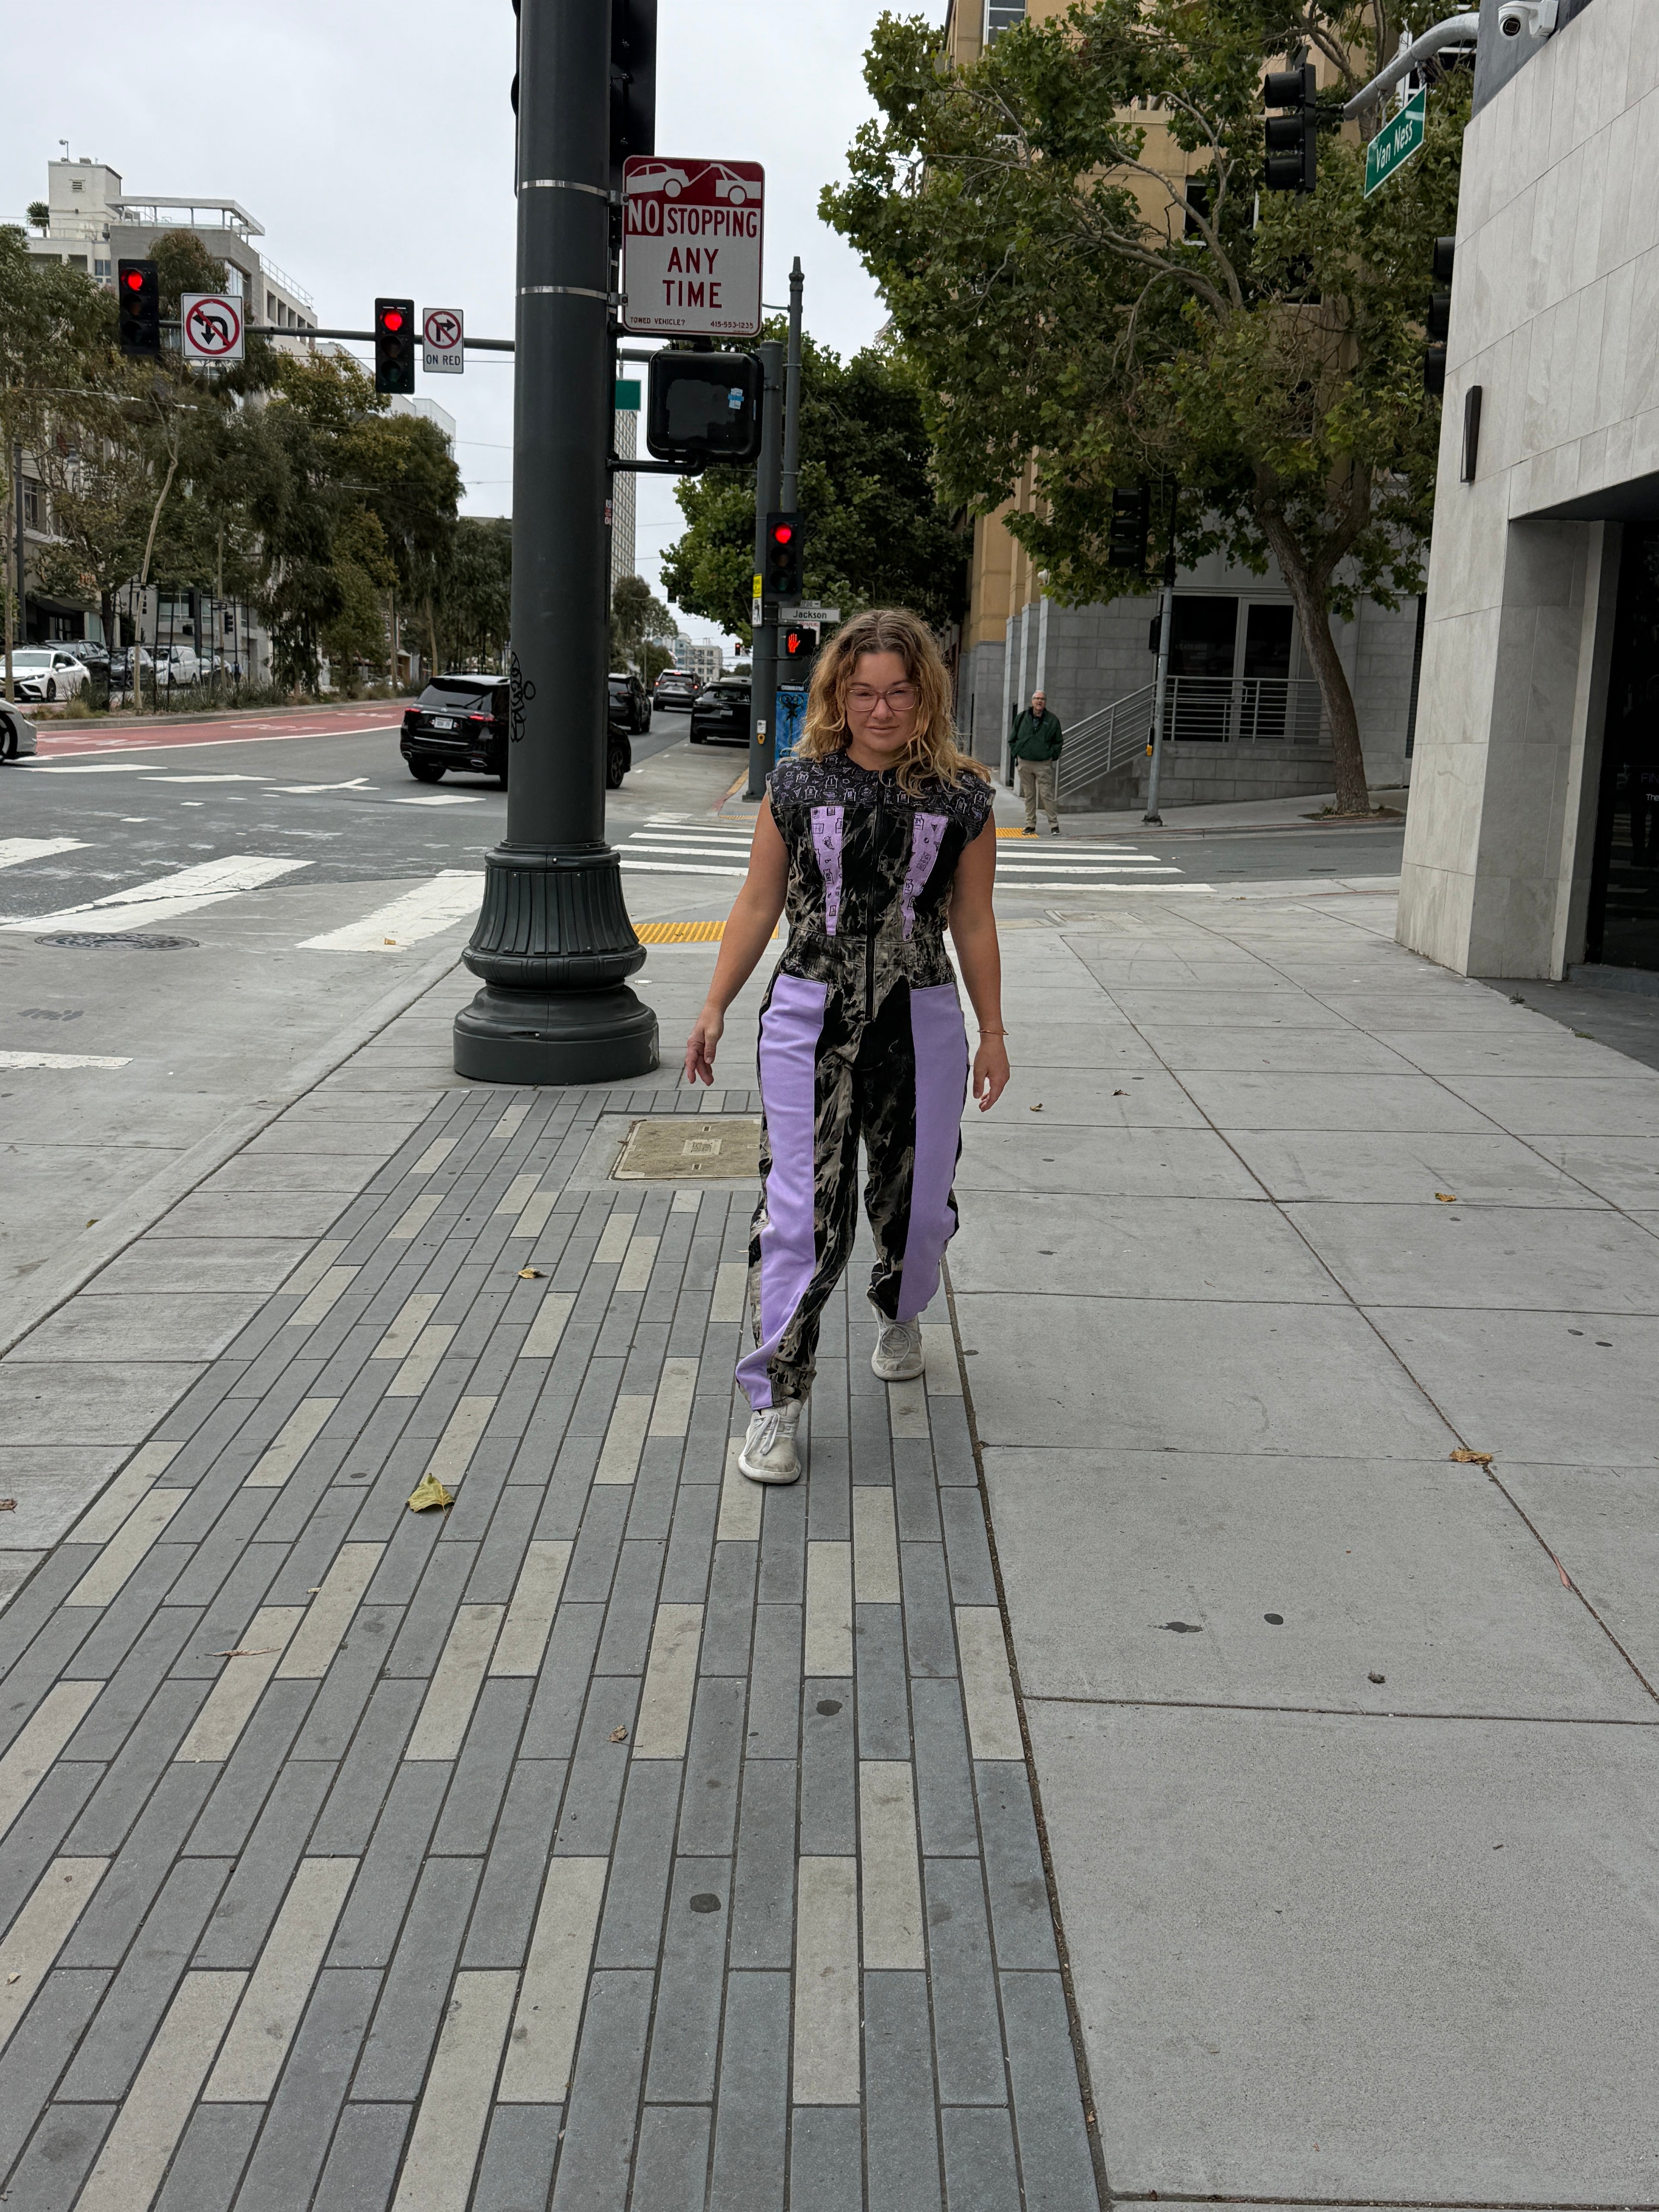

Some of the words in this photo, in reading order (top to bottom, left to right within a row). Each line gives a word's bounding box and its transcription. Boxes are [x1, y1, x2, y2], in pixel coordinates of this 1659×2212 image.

[1376, 143, 1391, 173] Van
[1394, 120, 1413, 156] Ness
[628, 199, 660, 233] NO
[667, 207, 757, 238] STOPPING
[667, 247, 719, 274] ANY
[662, 280, 722, 308] TIME
[426, 354, 438, 365] ON
[443, 355, 461, 365] RED
[793, 610, 827, 619] Jackson
